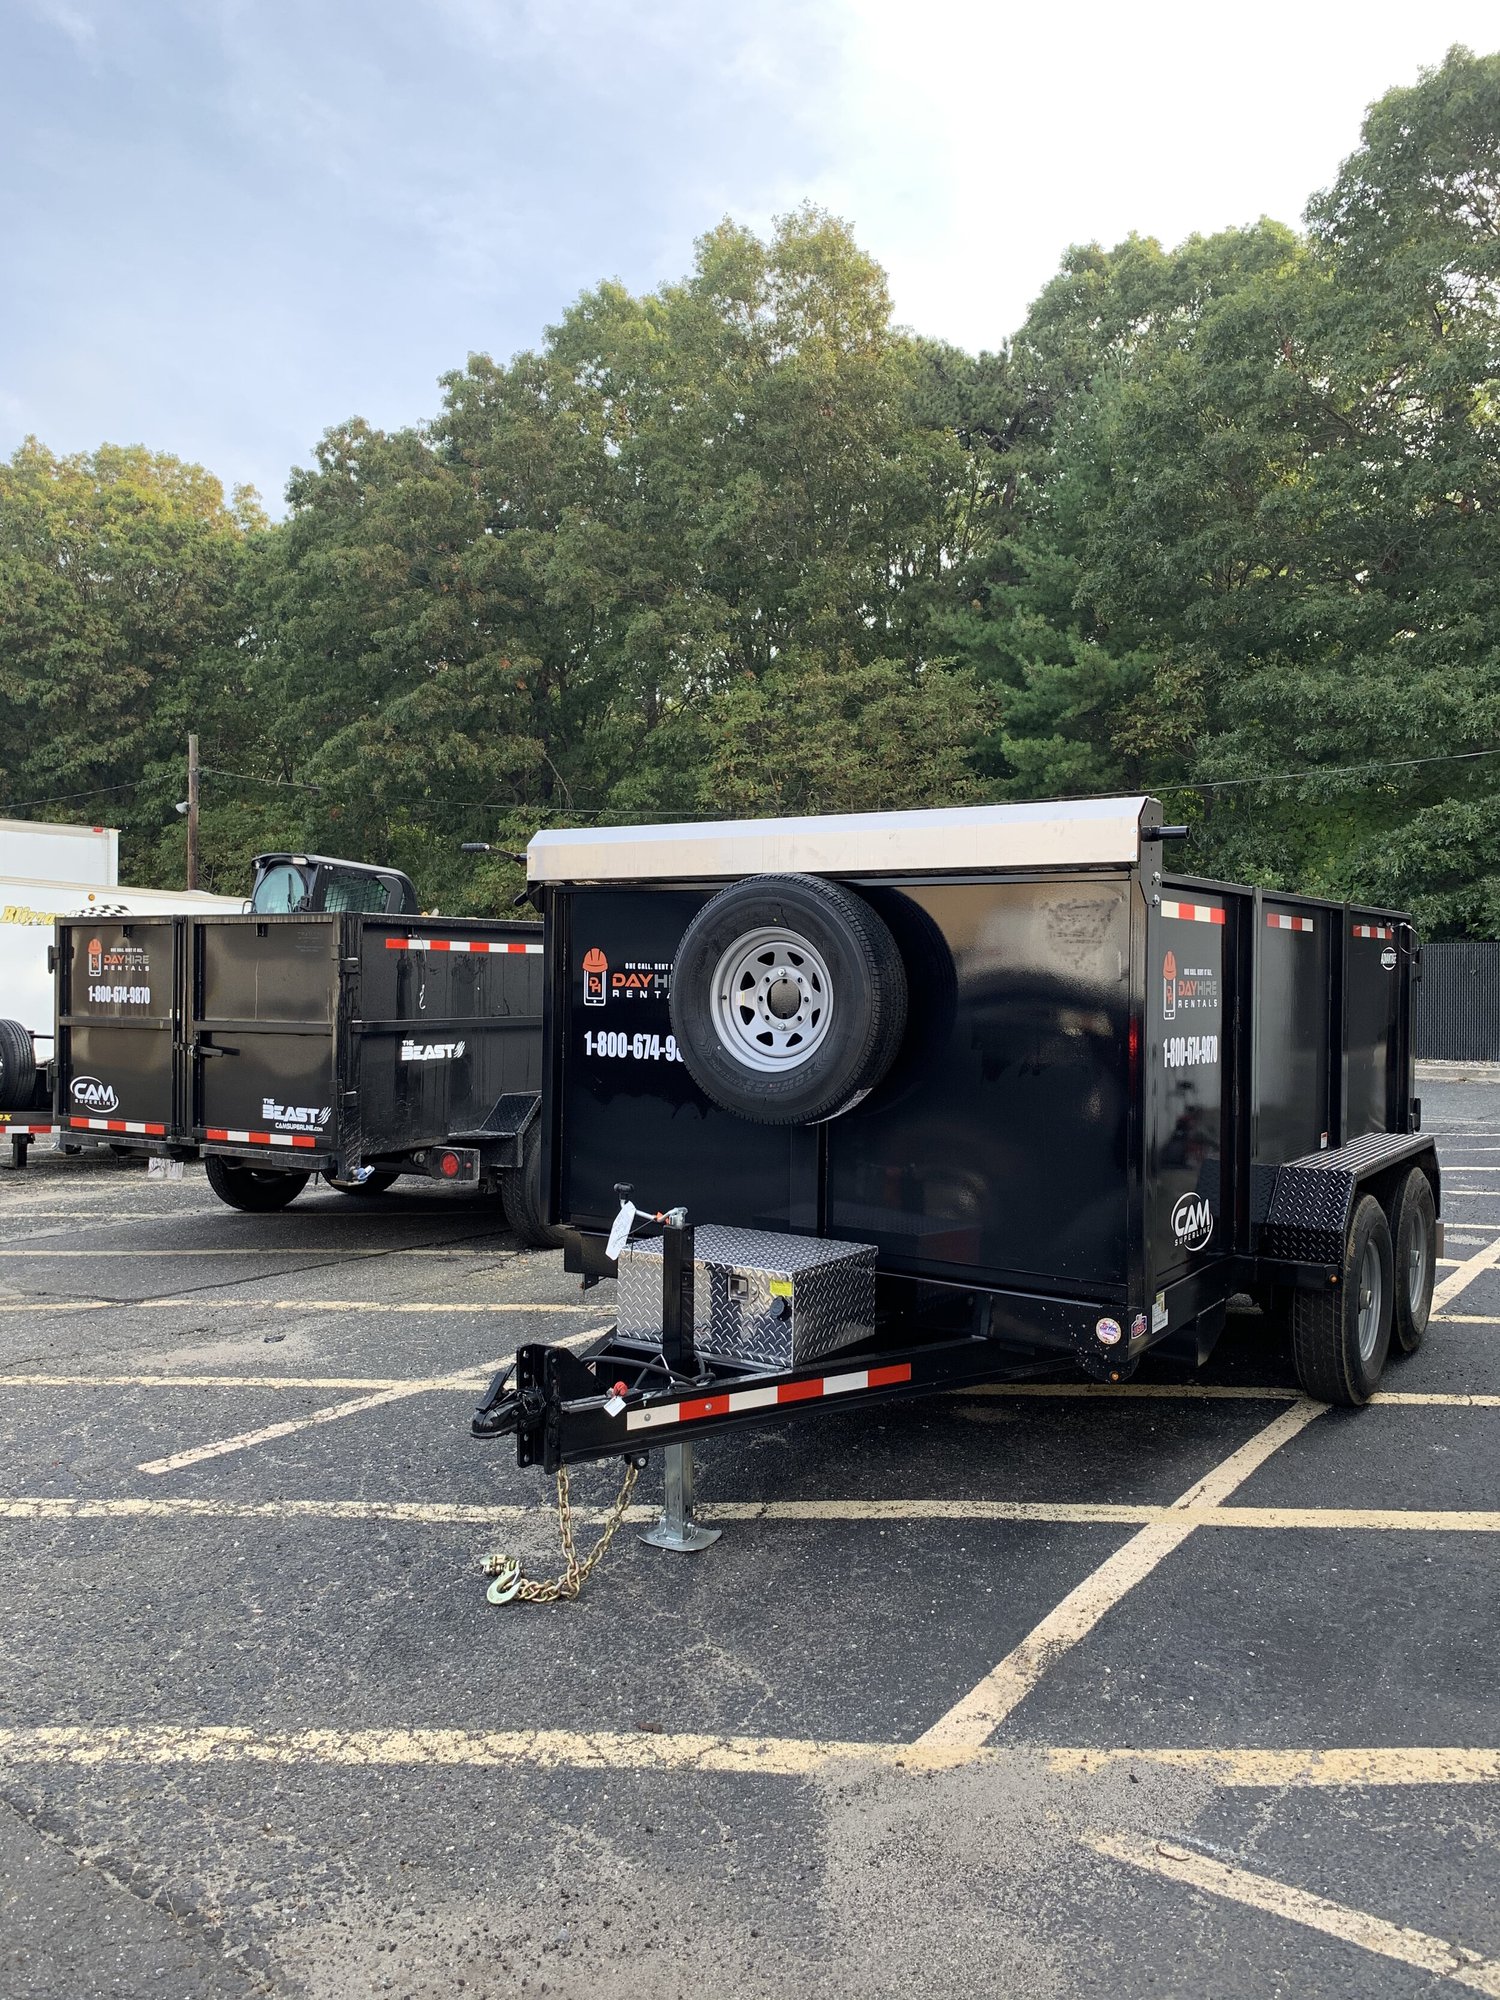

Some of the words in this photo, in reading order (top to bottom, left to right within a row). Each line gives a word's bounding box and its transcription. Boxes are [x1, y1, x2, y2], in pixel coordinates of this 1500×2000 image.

[1, 906, 65, 926] Blizza
[104, 955, 150, 964] DAYHIRE
[625, 962, 636, 970] ONE
[637, 962, 653, 970] CALL.
[612, 973, 671, 989] DAYHI
[1178, 980, 1217, 996] DAYHIRE
[88, 985, 150, 1004] 1-800-674-9870
[612, 989, 671, 999] RENT
[1178, 999, 1218, 1008] RENTALS
[401, 1044, 455, 1061] BEAST
[584, 1030, 684, 1062] 1-800-674-9
[1163, 1035, 1218, 1068] 1-800-674-9870
[74, 1083, 115, 1102] CAM
[262, 1104, 320, 1123] BEAST
[1174, 1199, 1211, 1237] CAM
[1174, 1225, 1211, 1247] SUPERLINE
